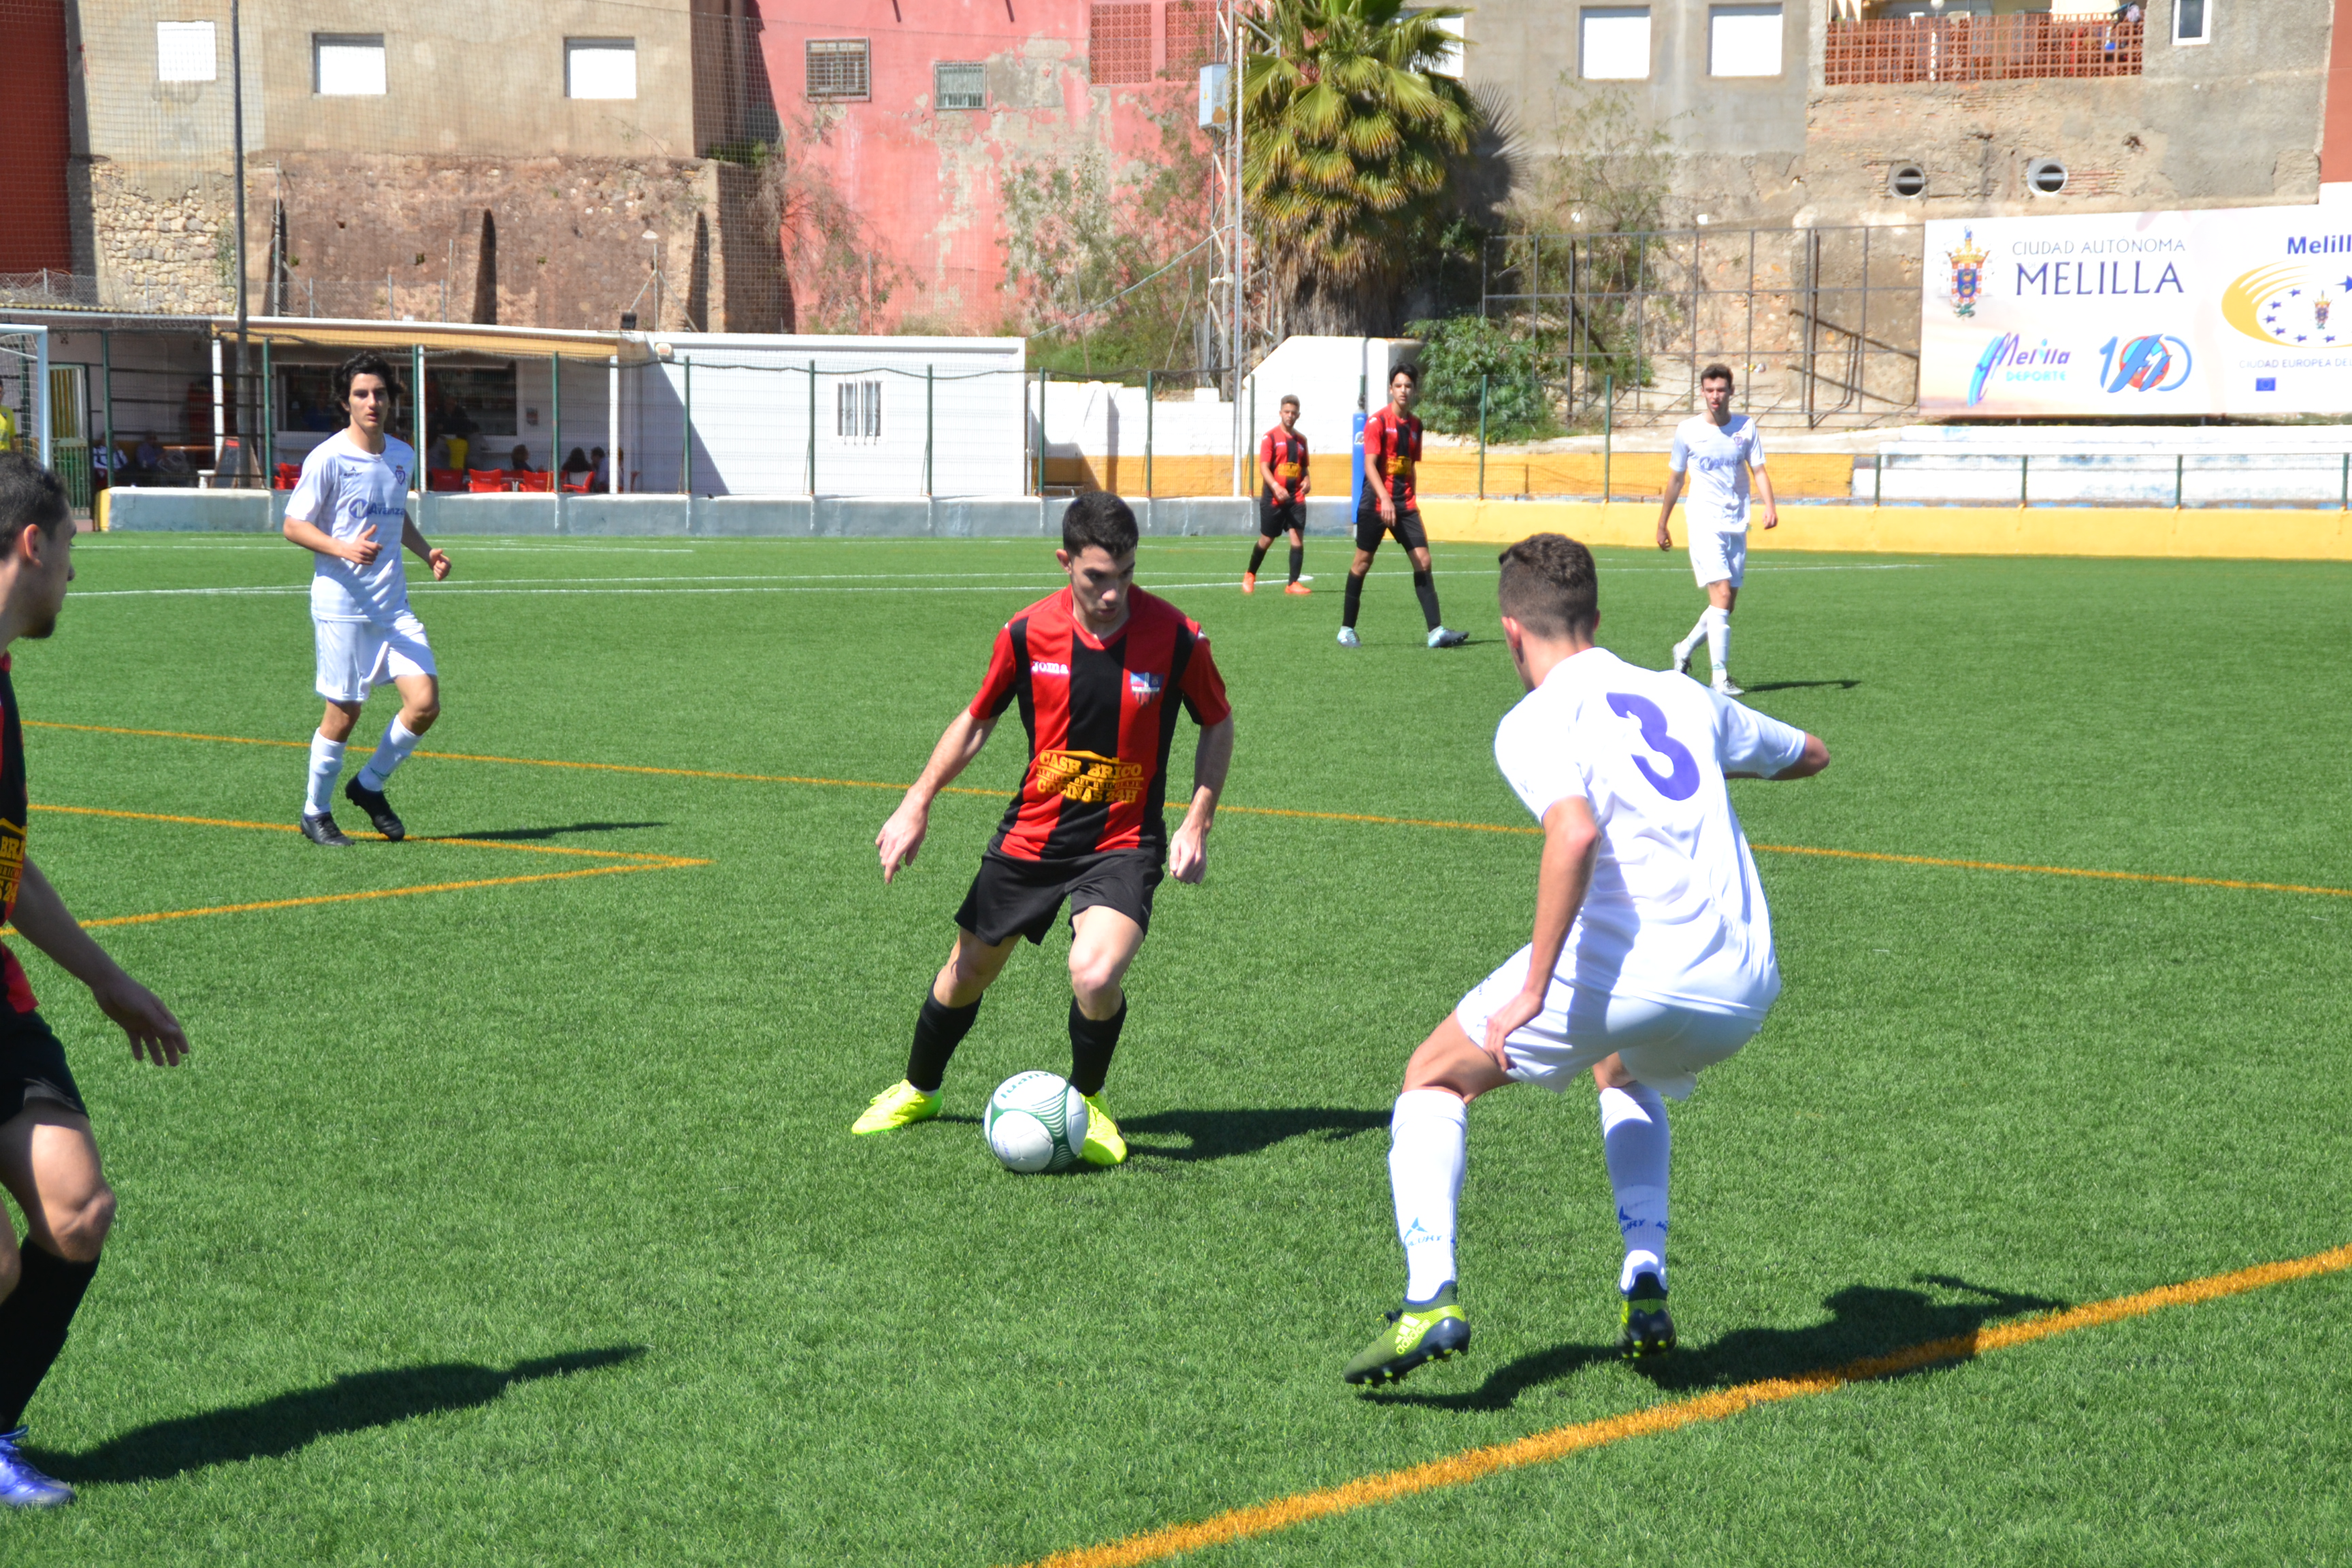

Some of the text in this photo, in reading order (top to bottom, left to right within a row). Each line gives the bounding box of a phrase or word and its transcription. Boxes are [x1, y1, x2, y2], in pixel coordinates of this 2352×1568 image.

[2012, 235, 2186, 256] CIUDAD AUTÓNOMA
[2016, 260, 2185, 295] MELILLA
[1978, 332, 2071, 388] Melilla
[2240, 359, 2279, 369] CIUDAD
[2282, 358, 2332, 368] EUROPEA
[2006, 371, 2065, 382] DEPORTE
[1606, 691, 1701, 802] 3
[1039, 751, 1143, 779] CASH BRICO
[1036, 779, 1138, 803] COCINAS 24H
[1396, 1319, 1431, 1355] adidas
